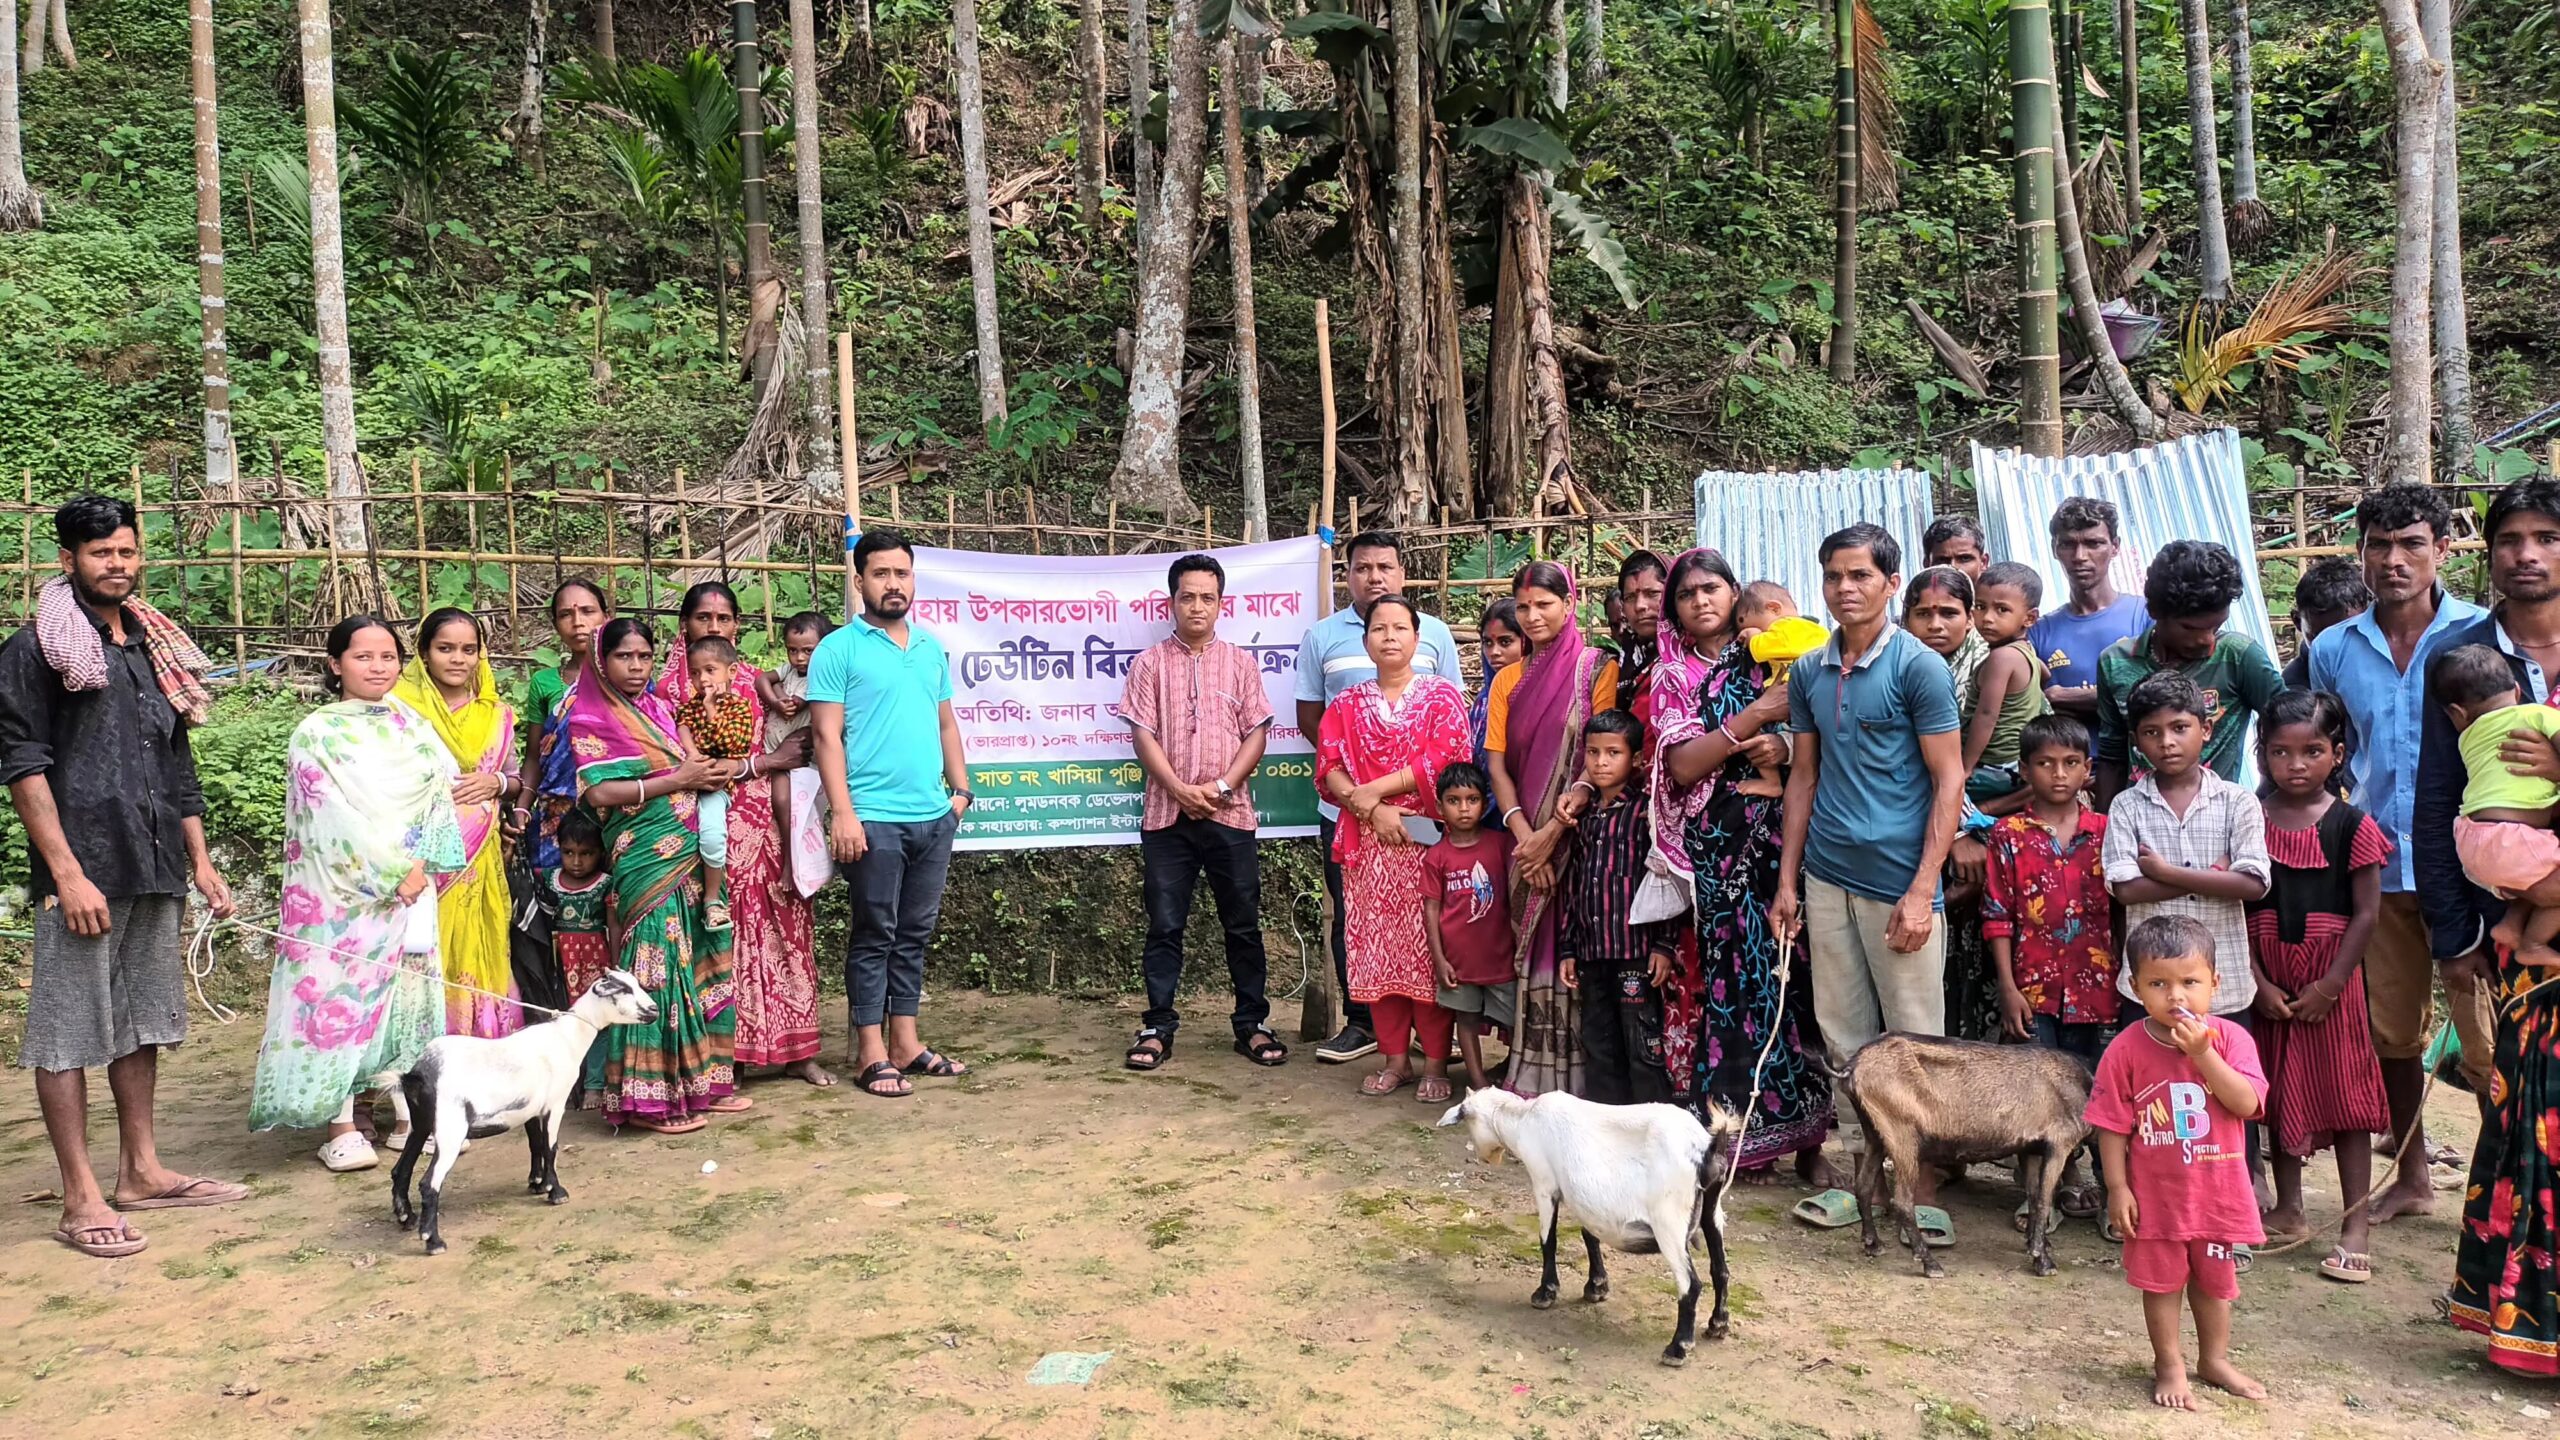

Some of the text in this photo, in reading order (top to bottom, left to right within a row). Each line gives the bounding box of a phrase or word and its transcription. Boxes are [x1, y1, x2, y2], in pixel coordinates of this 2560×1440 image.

[968, 591, 1120, 625] উপকারভোগী
[1243, 590, 1302, 617] মাঝে
[961, 635, 1075, 689] ঢেউটিন
[955, 699, 1032, 723] অতিথি:
[1039, 702, 1097, 723] জনাব
[975, 770, 1014, 788] সাত
[1017, 770, 1042, 788] নং
[1048, 764, 1103, 786] খাসিয়া
[1266, 761, 1313, 777] ০৪০১
